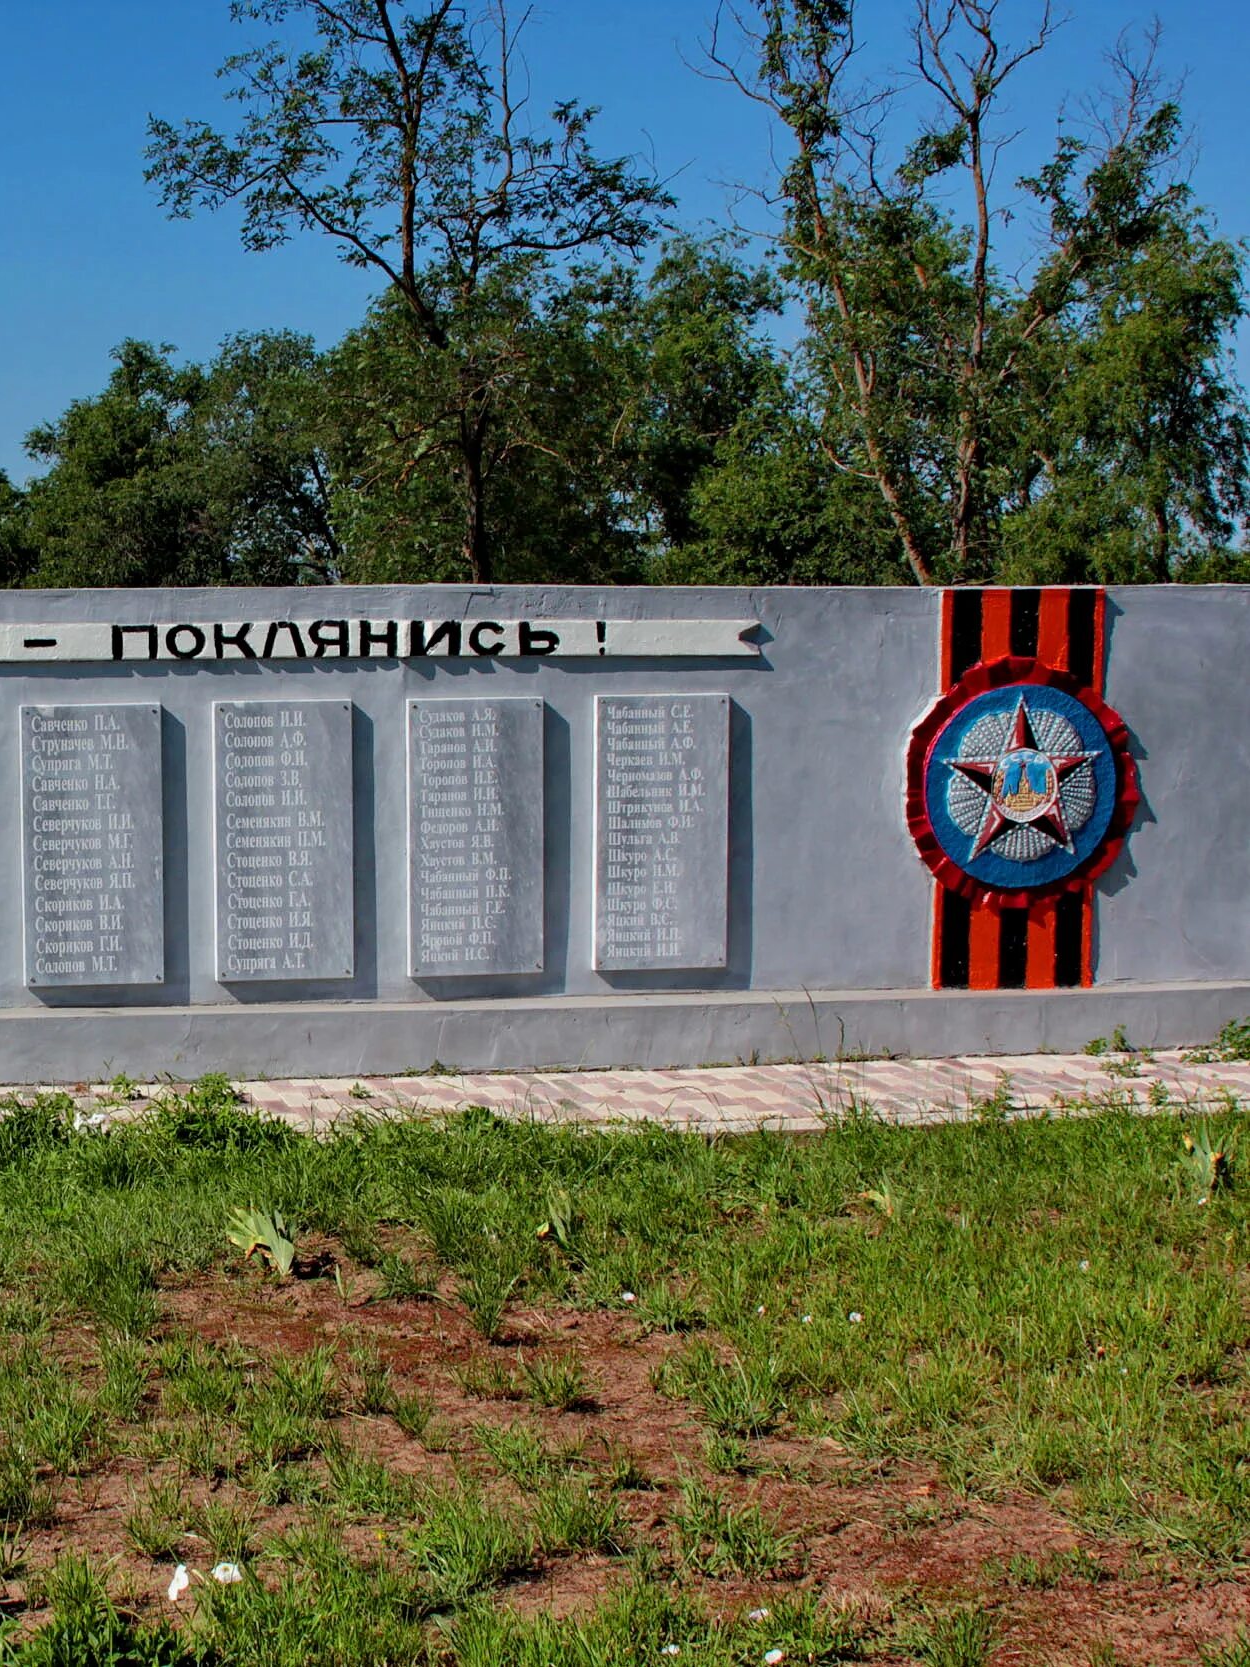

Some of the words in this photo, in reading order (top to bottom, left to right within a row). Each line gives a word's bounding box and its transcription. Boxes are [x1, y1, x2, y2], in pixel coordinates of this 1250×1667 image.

[32, 717, 87, 733] Савченко
[32, 736, 94, 755] Струначев
[225, 733, 273, 748] Солопов
[280, 731, 306, 748] А.Ф.
[32, 755, 81, 775] Супряга
[88, 754, 113, 770] М.Т.
[32, 776, 87, 792] Савченко
[225, 772, 273, 788] Солопов
[280, 771, 302, 788] З.В.
[33, 796, 88, 812] Савченко
[95, 794, 115, 809] Т.Г.
[298, 812, 324, 827] В.М.
[33, 835, 101, 854] Северчуков
[108, 833, 133, 849] М.Г.
[227, 852, 282, 868] Стоценко
[288, 851, 313, 866] В.Я.
[35, 875, 102, 895] Северчуков
[227, 872, 282, 888] Стоценко
[288, 871, 313, 886] С.А.
[35, 897, 93, 915] Скориков
[228, 893, 282, 910] Стоценко
[288, 892, 311, 907] Г.А.
[35, 917, 93, 936] Скориков
[228, 914, 282, 930] Стоценко
[36, 938, 93, 957] Скориков
[228, 935, 283, 950] Стоценко
[228, 955, 276, 974] Супряга
[283, 953, 305, 968] А.Т.
